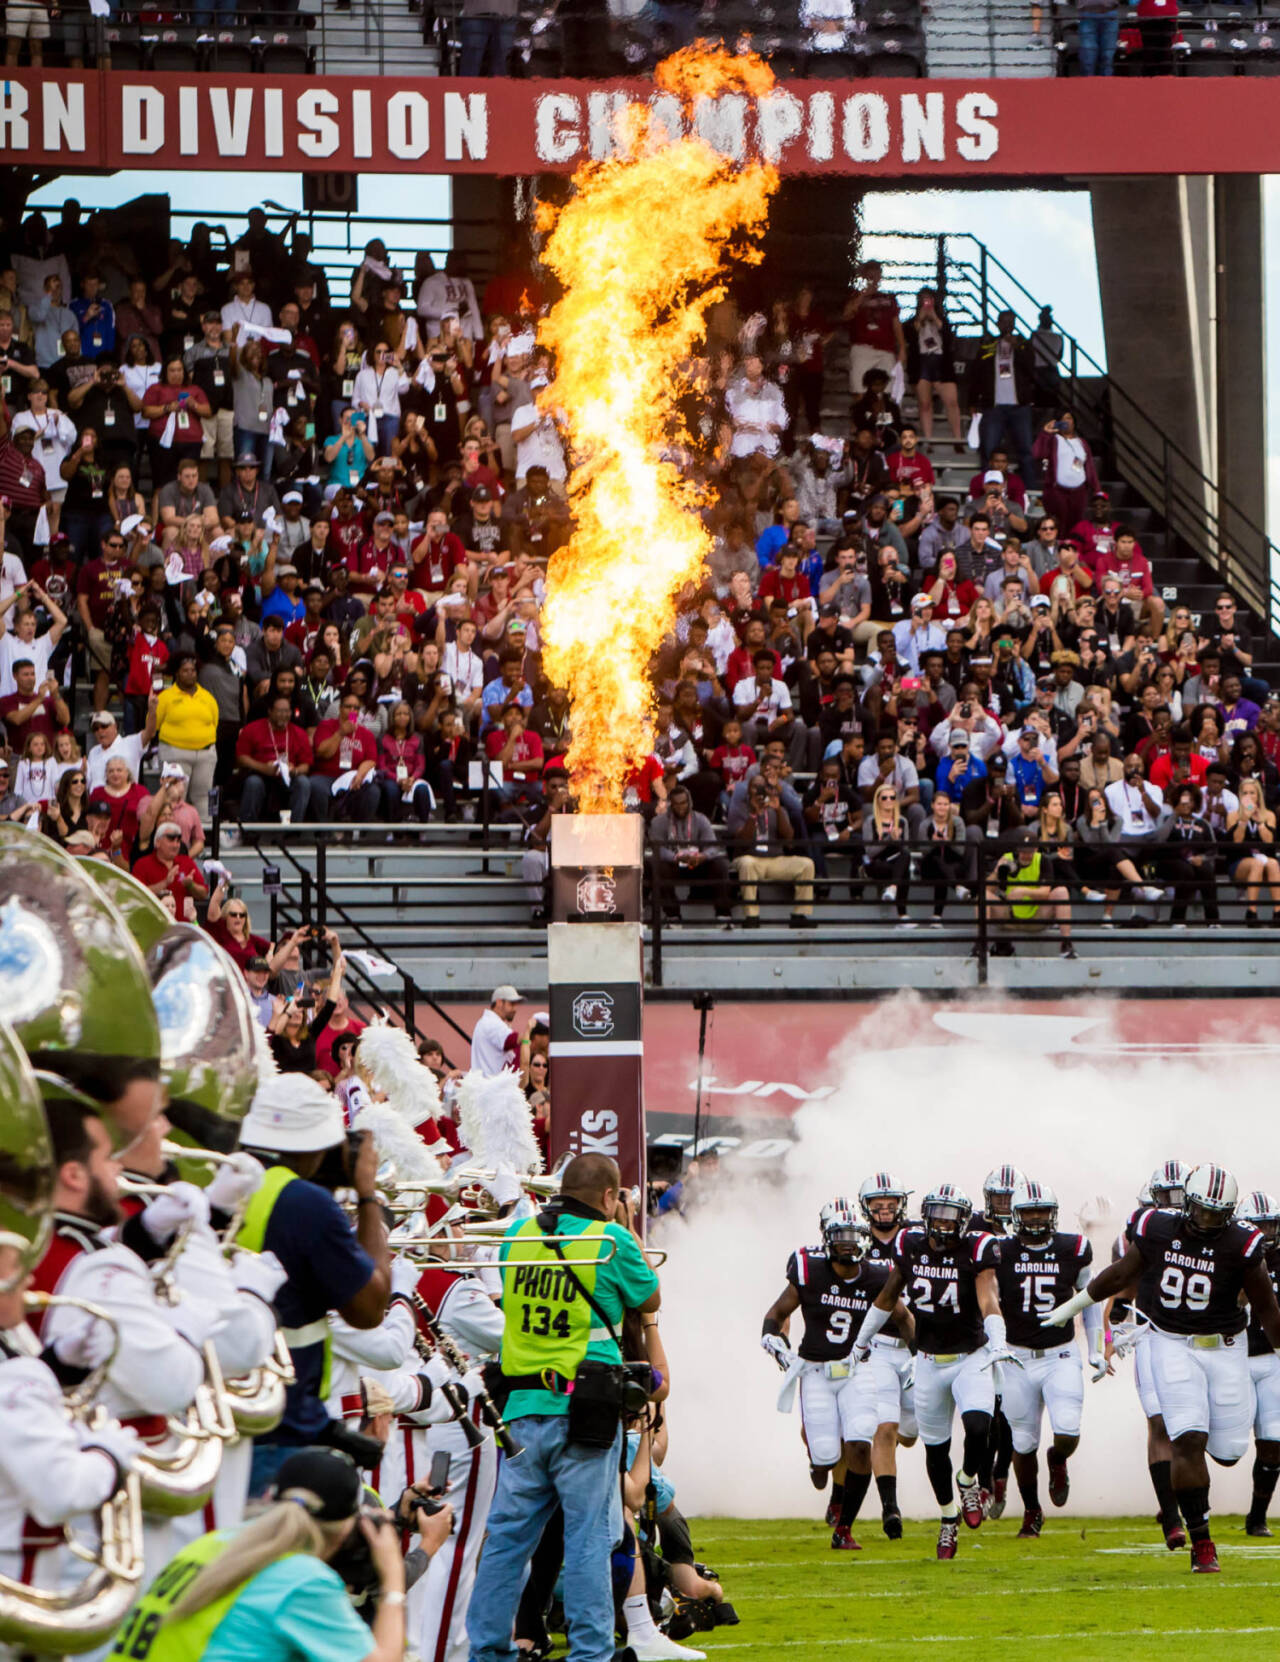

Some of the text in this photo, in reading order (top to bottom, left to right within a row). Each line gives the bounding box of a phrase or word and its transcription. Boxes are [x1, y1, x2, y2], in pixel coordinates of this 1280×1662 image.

[122, 85, 489, 160] DIVISION
[912, 1264, 959, 1280] CAROLINA
[1014, 1262, 1060, 1273] CAROLINA
[1164, 1250, 1215, 1273] CAROLINA
[513, 1266, 577, 1303] PHOTO
[820, 1293, 868, 1311] CAROLINA
[912, 1277, 960, 1314] 24
[1020, 1275, 1056, 1313] 15
[1160, 1266, 1213, 1311] 99
[521, 1303, 571, 1338] 134
[826, 1310, 853, 1344] 9
